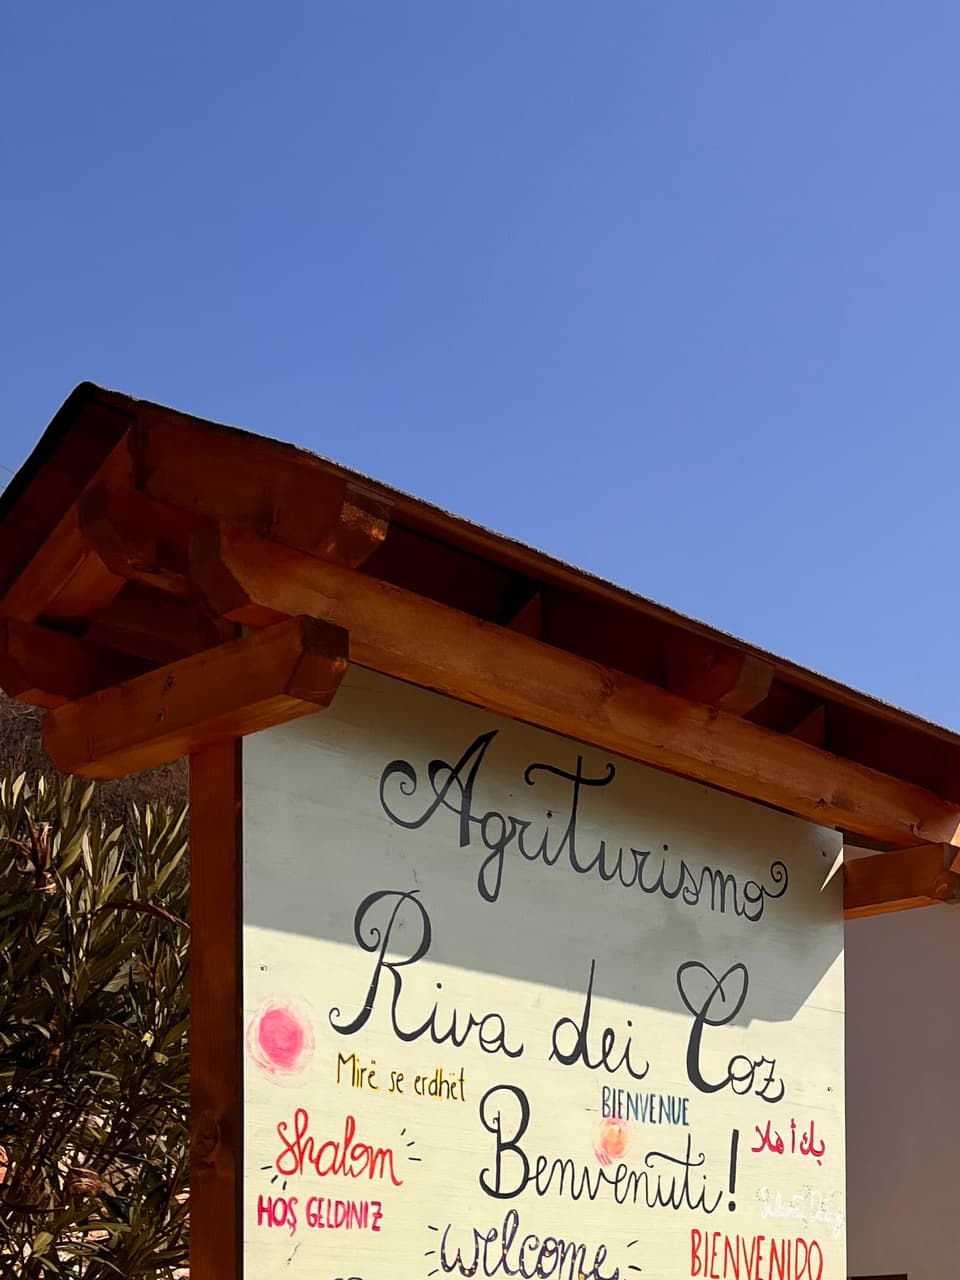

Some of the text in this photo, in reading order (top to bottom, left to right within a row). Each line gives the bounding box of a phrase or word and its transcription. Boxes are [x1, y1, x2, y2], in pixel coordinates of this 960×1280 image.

[329, 889, 785, 1103] Riva dei Coz
[388, 1067, 403, 1094] se
[602, 1086, 690, 1126] BIENVENUE
